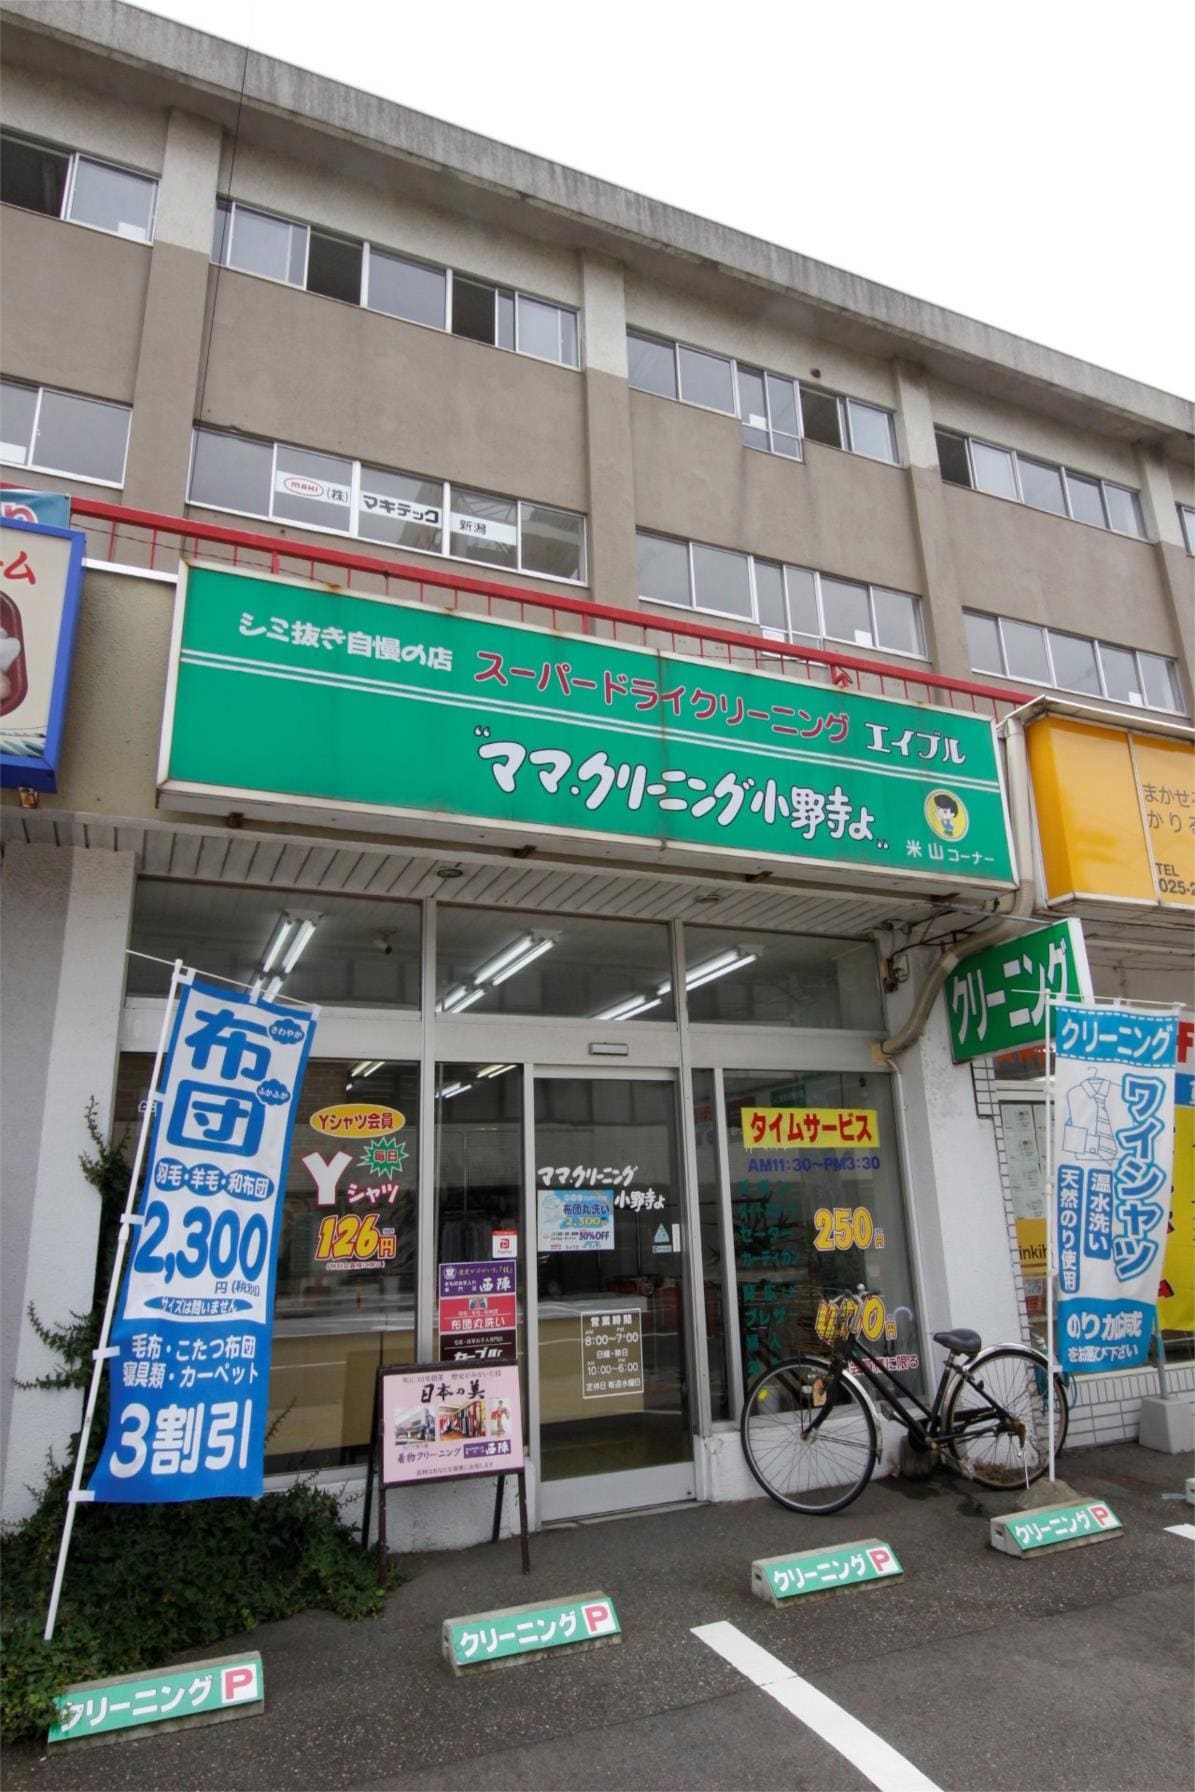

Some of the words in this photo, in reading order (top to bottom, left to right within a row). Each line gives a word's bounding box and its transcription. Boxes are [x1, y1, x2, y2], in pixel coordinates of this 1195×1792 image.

[363, 494, 439, 523] マキテック
[459, 519, 487, 536] 新潟
[0, 551, 36, 585] ム
[238, 612, 453, 671] シミ抜き自慢の店
[473, 649, 850, 743] スーパードライクリーニング
[863, 721, 967, 765] エイブル
[906, 839, 995, 864] 米山コーナー
[1155, 862, 1180, 877] TEL
[952, 938, 1068, 1044] クリーニング
[1061, 1018, 1174, 1060] クリーニング
[166, 1009, 272, 1157] 布団
[319, 1113, 394, 1131] Yシャツ会員
[750, 1112, 873, 1143] タイムサービス
[373, 1149, 399, 1163] 毎日
[1113, 1073, 1167, 1283] ワイシャツ
[614, 1187, 666, 1212] 小野寺よ
[1089, 1171, 1112, 1251] 温水洗い
[134, 1200, 269, 1285] 2,300
[1060, 1169, 1080, 1292] 天然のり使用
[1066, 1311, 1144, 1341] のり加減
[132, 1333, 256, 1361] 毛布・こたつ布団
[123, 1361, 258, 1389] 寝具類・カーペット
[109, 1398, 253, 1478] 3割引
[1014, 1511, 1090, 1545] クリーニング
[1093, 1505, 1110, 1527] P
[773, 1553, 867, 1592] クリーニング
[869, 1549, 891, 1572] P
[459, 1610, 577, 1658] クリーニング
[586, 1606, 610, 1633] P
[225, 1667, 255, 1700] P
